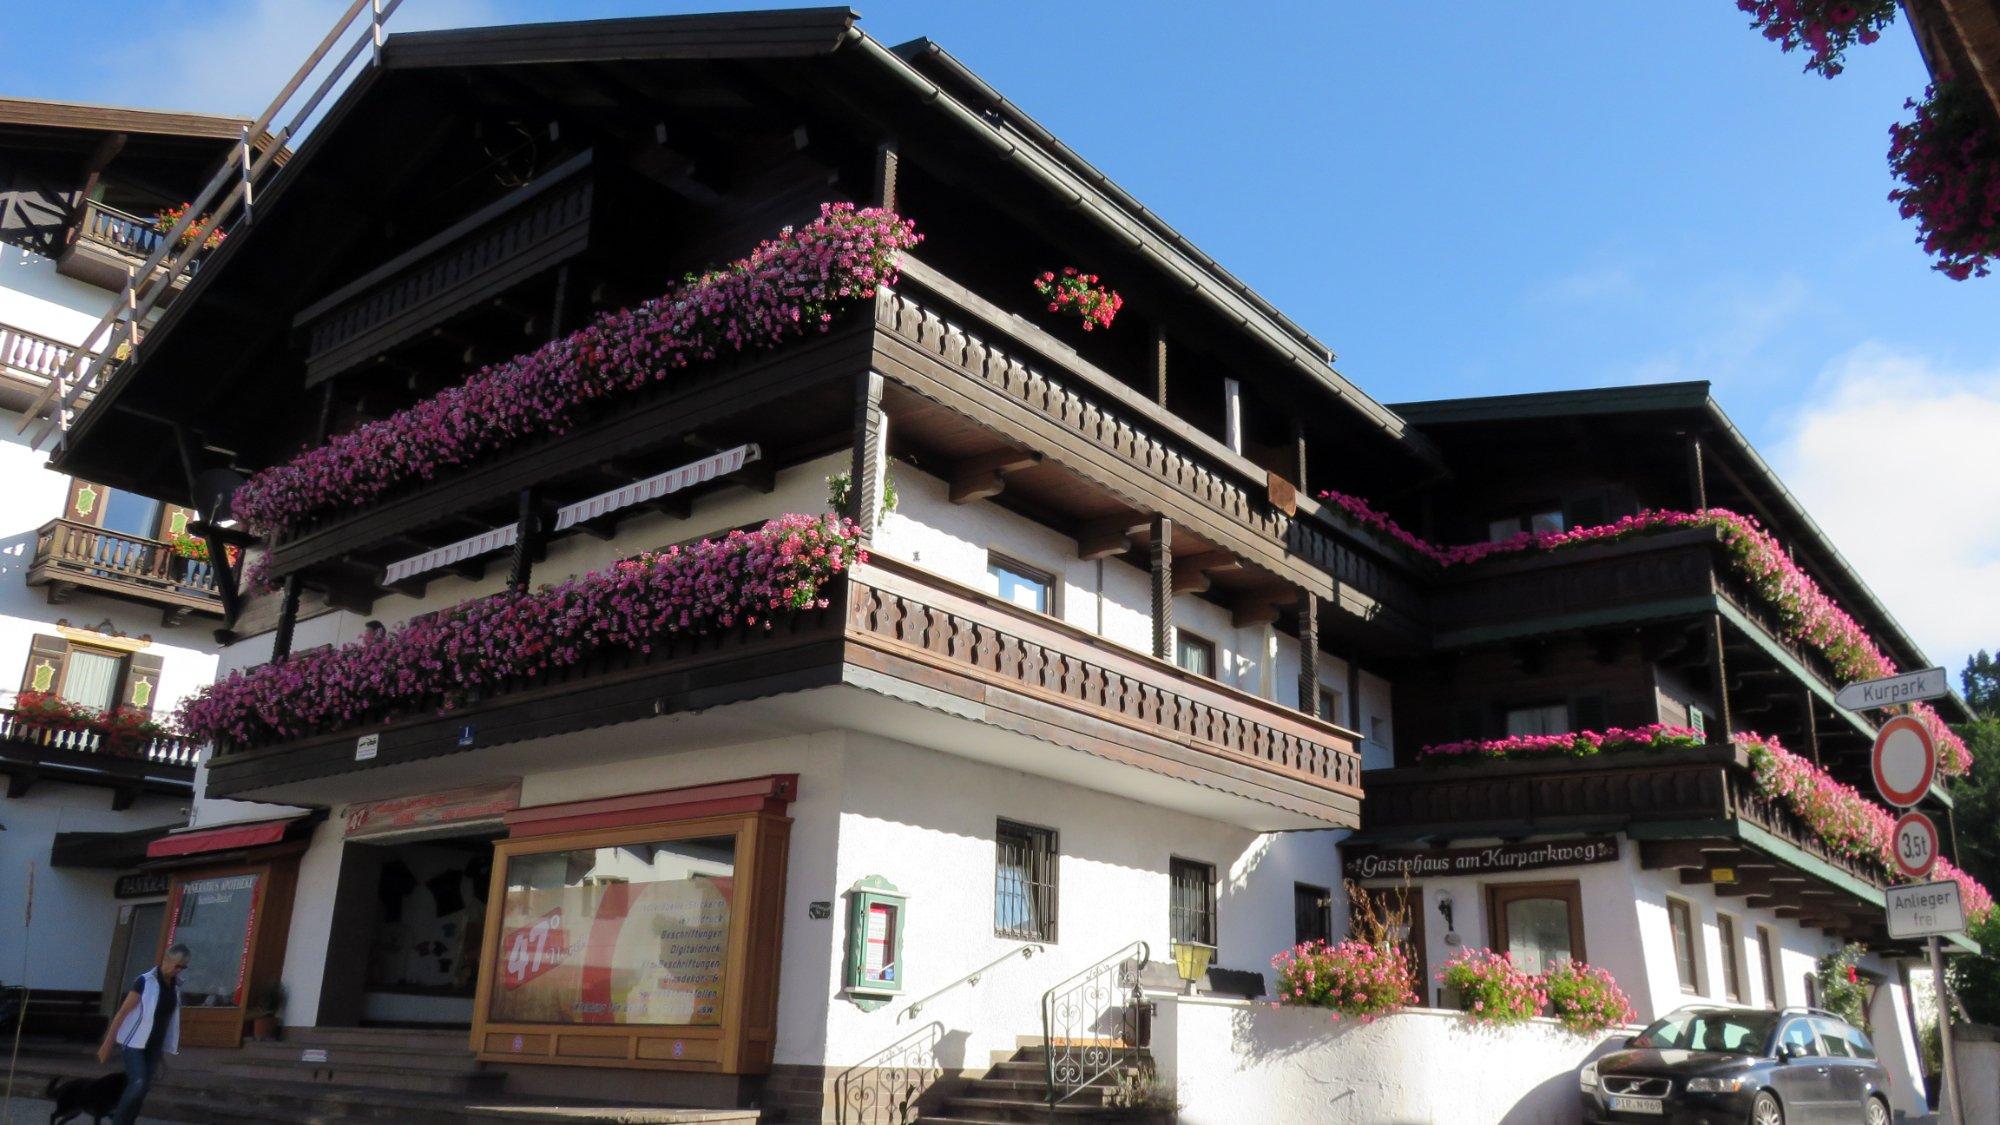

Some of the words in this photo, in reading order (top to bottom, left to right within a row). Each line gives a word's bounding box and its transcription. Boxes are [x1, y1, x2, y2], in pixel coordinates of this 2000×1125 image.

[1863, 677, 1927, 703] Kurpark
[1455, 855, 1480, 869] am
[1482, 842, 1596, 870] Kurparkweg
[1902, 832, 1928, 860] 3,5t
[1895, 890, 1951, 910] Anlieger
[1913, 911, 1938, 927] frei
[670, 943, 721, 956] Digitaldruck
